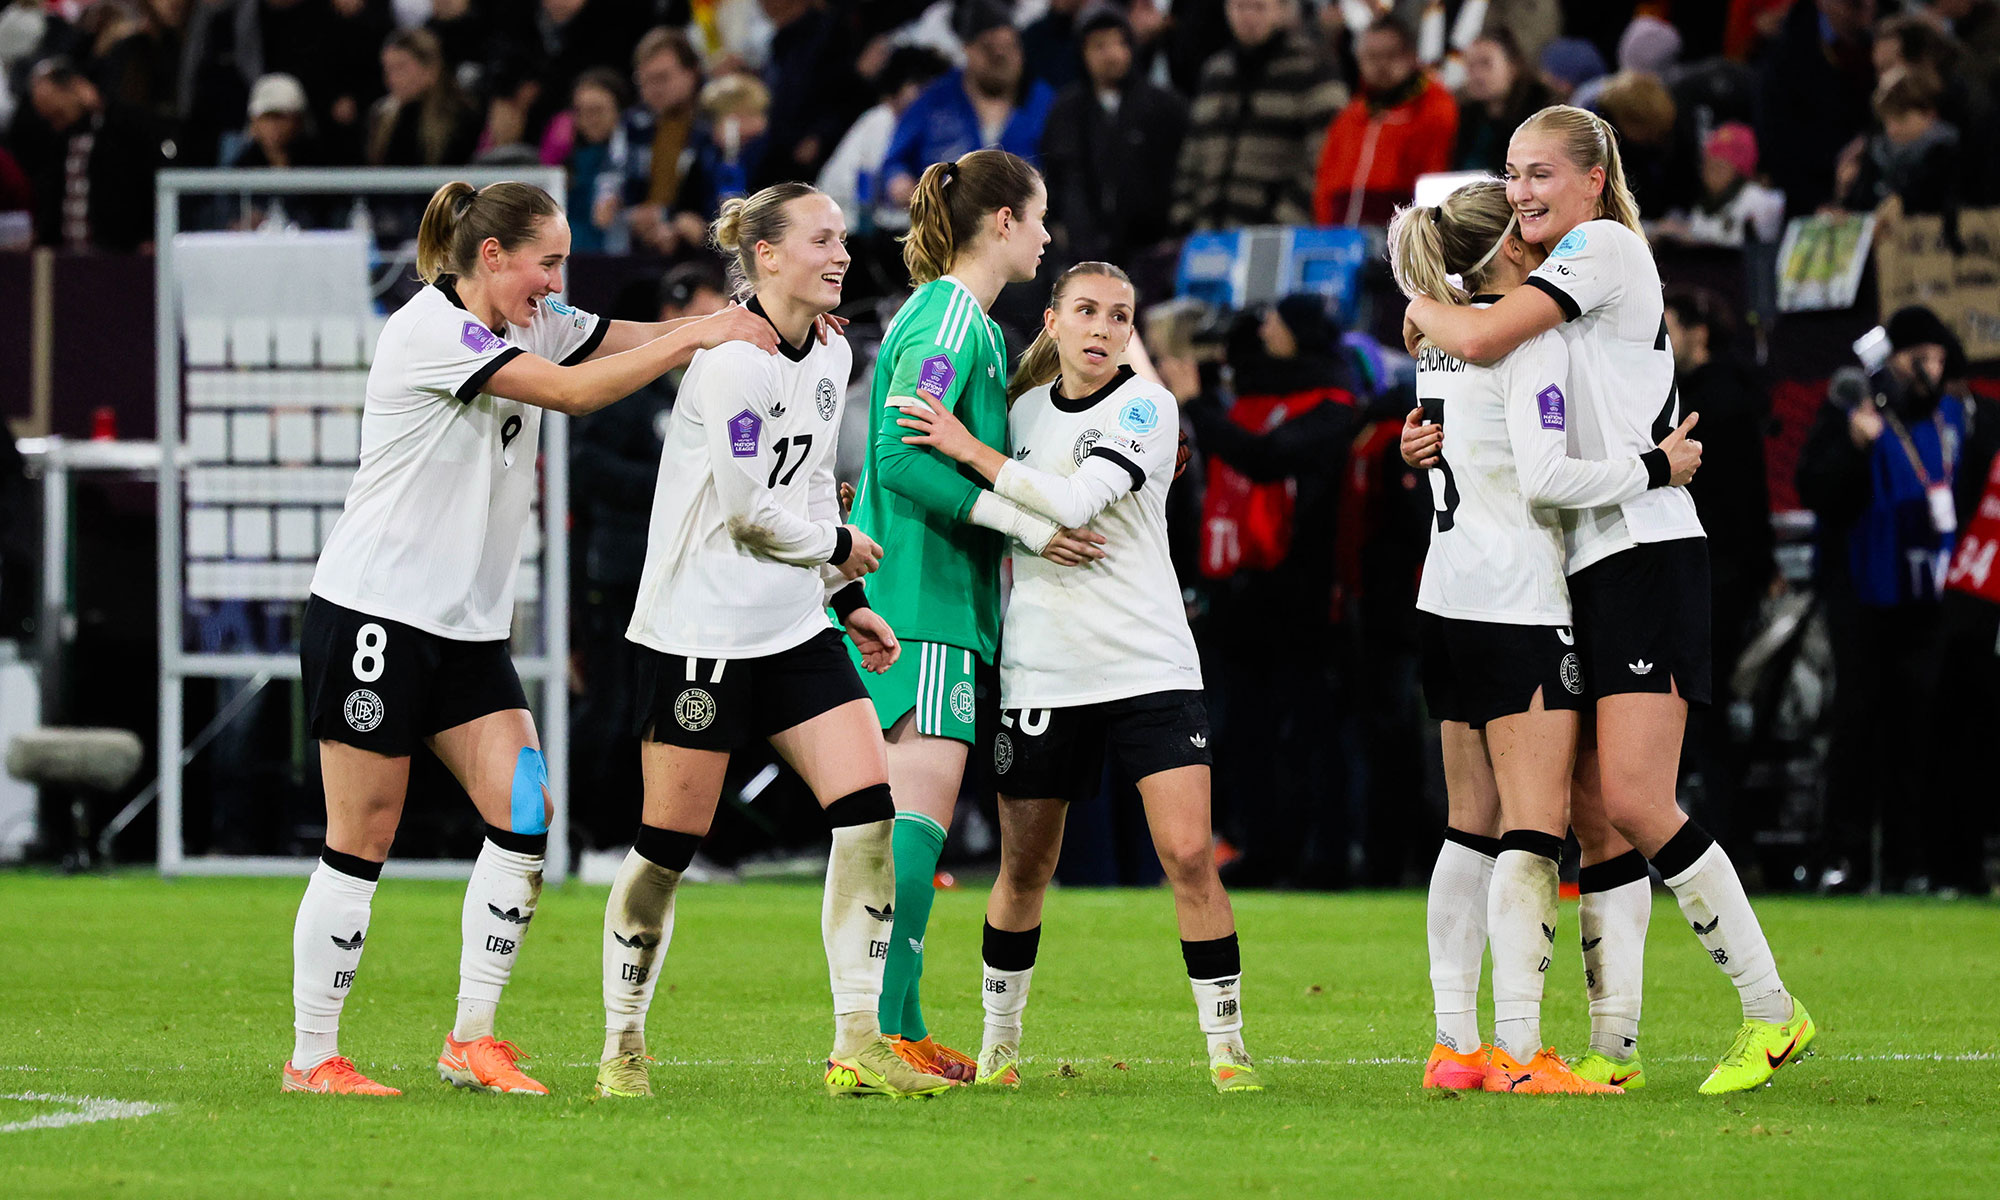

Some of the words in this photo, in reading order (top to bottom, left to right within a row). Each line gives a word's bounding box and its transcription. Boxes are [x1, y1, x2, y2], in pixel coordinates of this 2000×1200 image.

[921, 381, 943, 392] NATIONS
[768, 434, 812, 489] 17
[352, 623, 387, 682] 8
